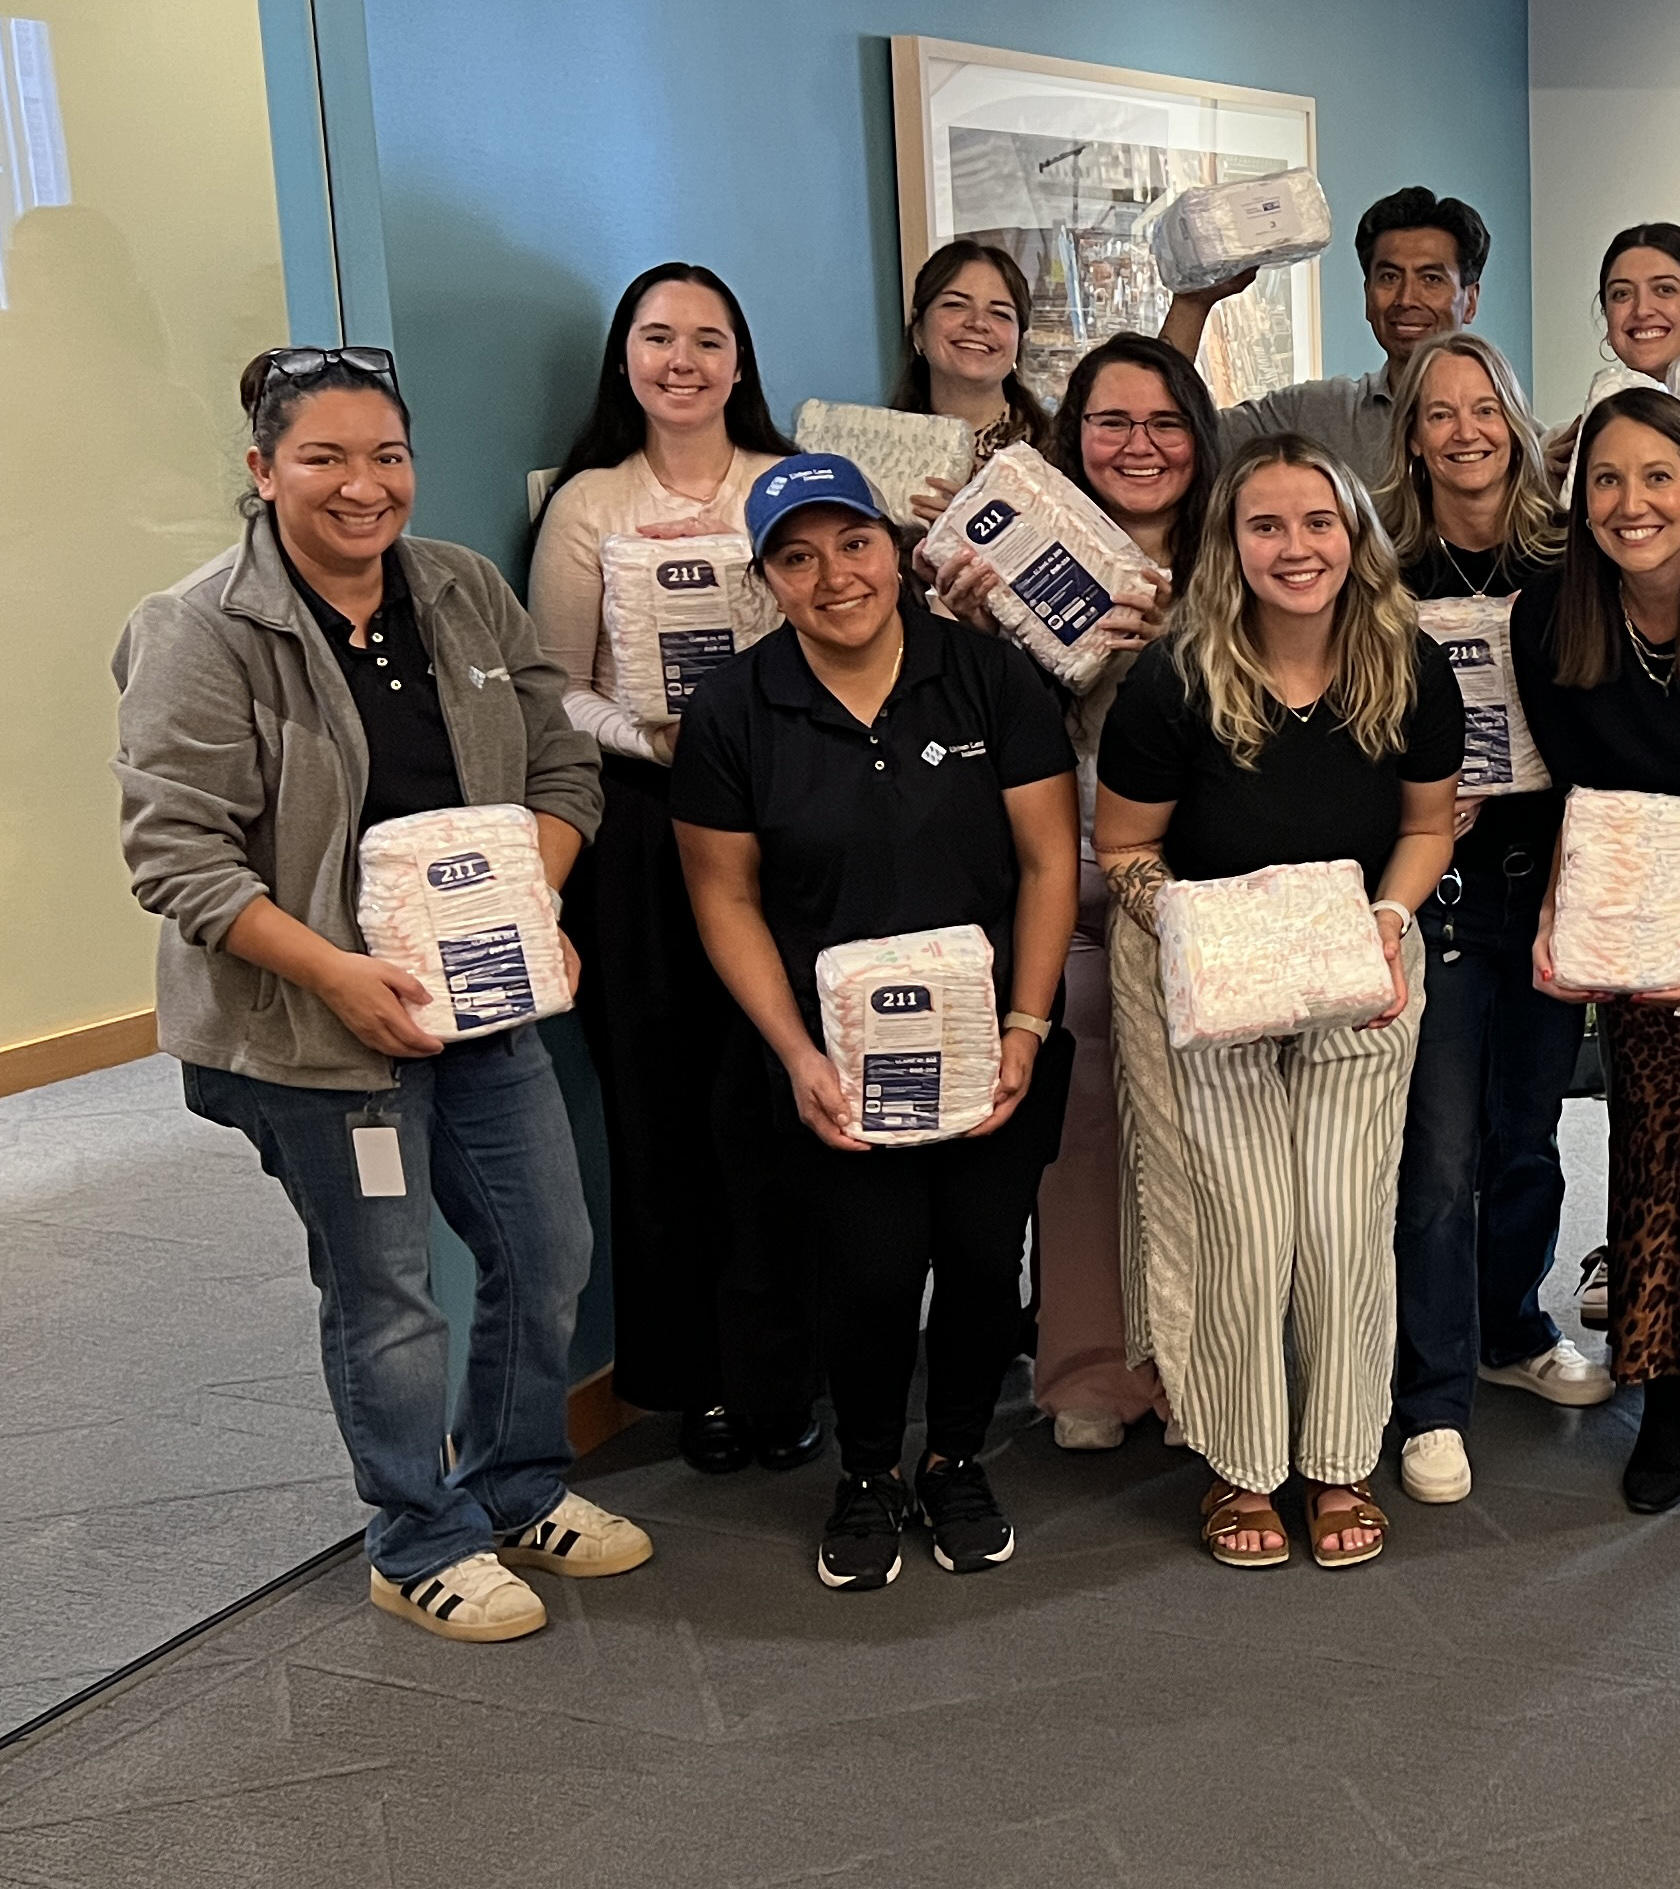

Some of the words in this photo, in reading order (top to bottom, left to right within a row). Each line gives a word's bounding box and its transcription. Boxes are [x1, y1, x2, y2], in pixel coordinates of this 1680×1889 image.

[974, 509, 1003, 536] 211
[667, 566, 700, 582] 211
[1448, 645, 1480, 661] 211
[439, 862, 476, 882] 211
[882, 991, 918, 1007] 211
